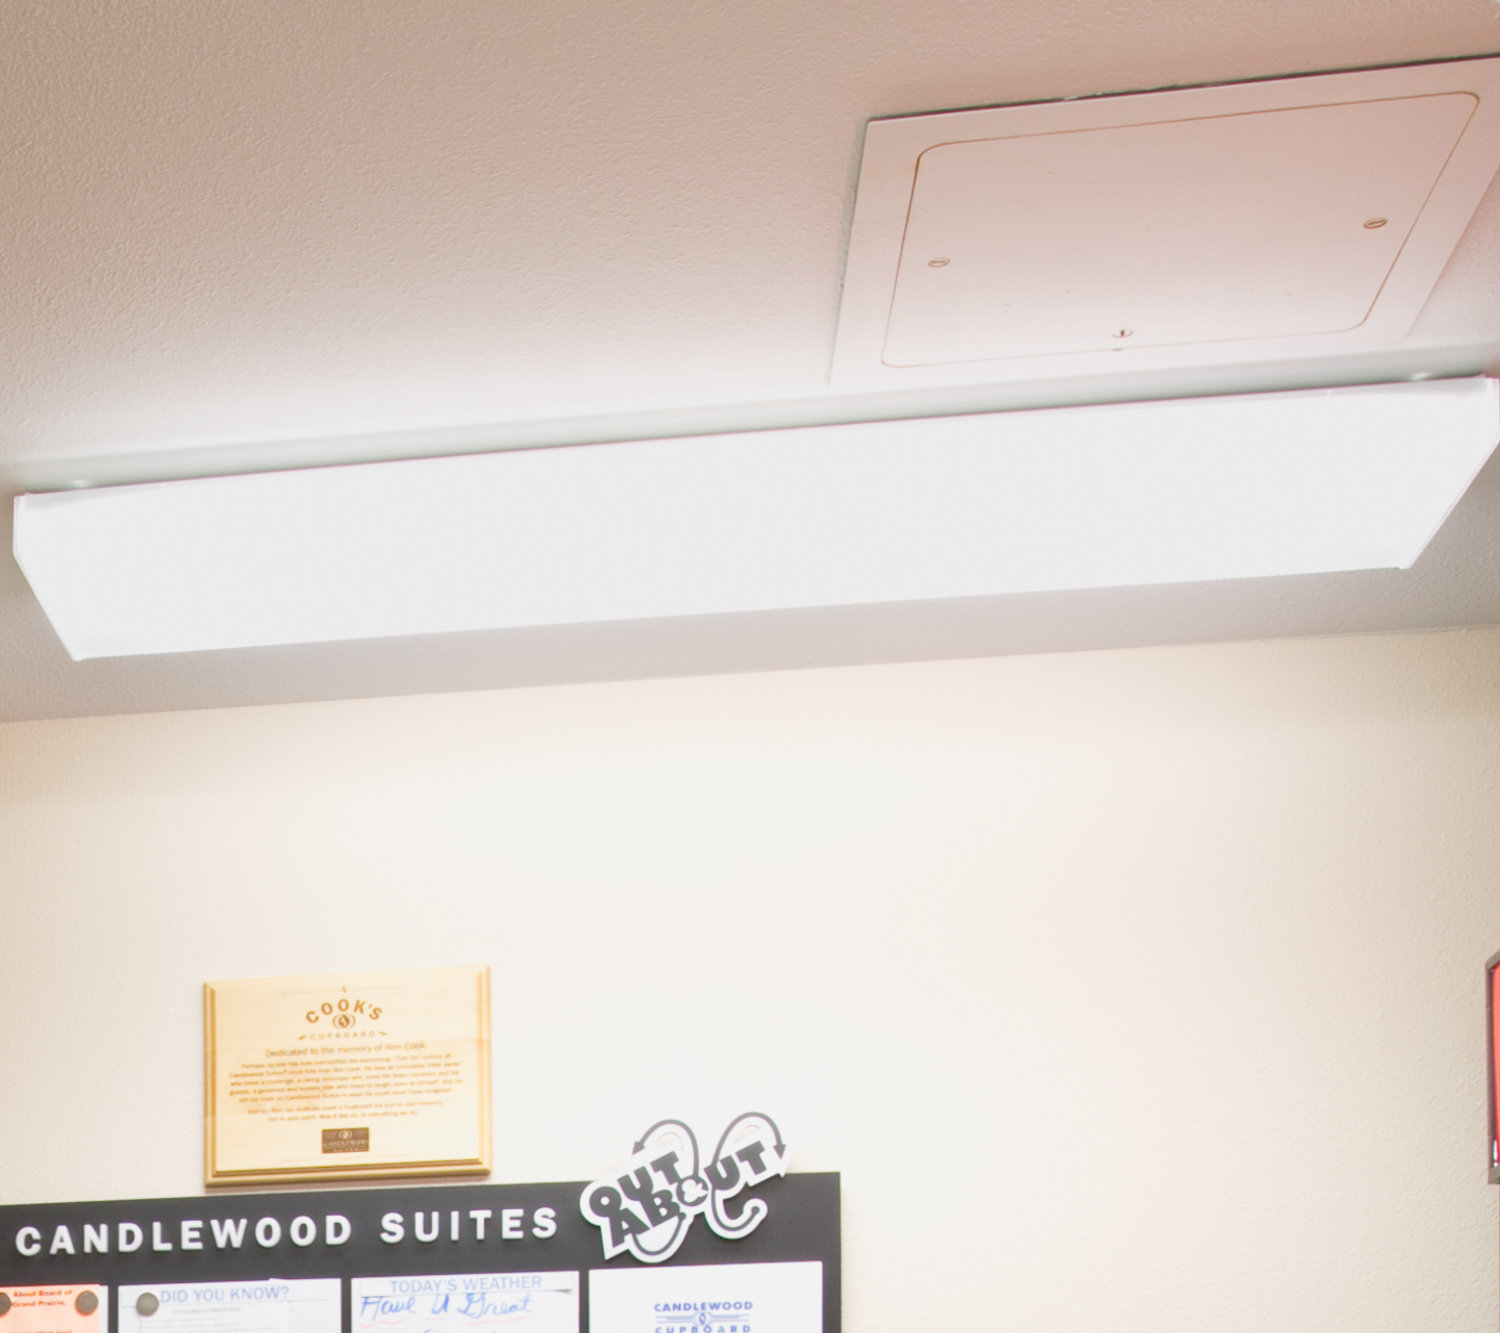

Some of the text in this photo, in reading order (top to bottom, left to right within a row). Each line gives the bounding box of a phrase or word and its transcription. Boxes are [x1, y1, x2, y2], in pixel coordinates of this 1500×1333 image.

[306, 998, 383, 1023] COOK'S
[310, 1030, 376, 1040] CUPBOARD
[266, 1047, 308, 1057] Dedicated
[15, 1207, 558, 1257] CANDLEWOOD SUITES
[390, 1276, 542, 1294] TODAY'S WEATHER
[161, 1286, 289, 1303] DID YOU KNOW?
[654, 1301, 753, 1312] CANDLEWOOD
